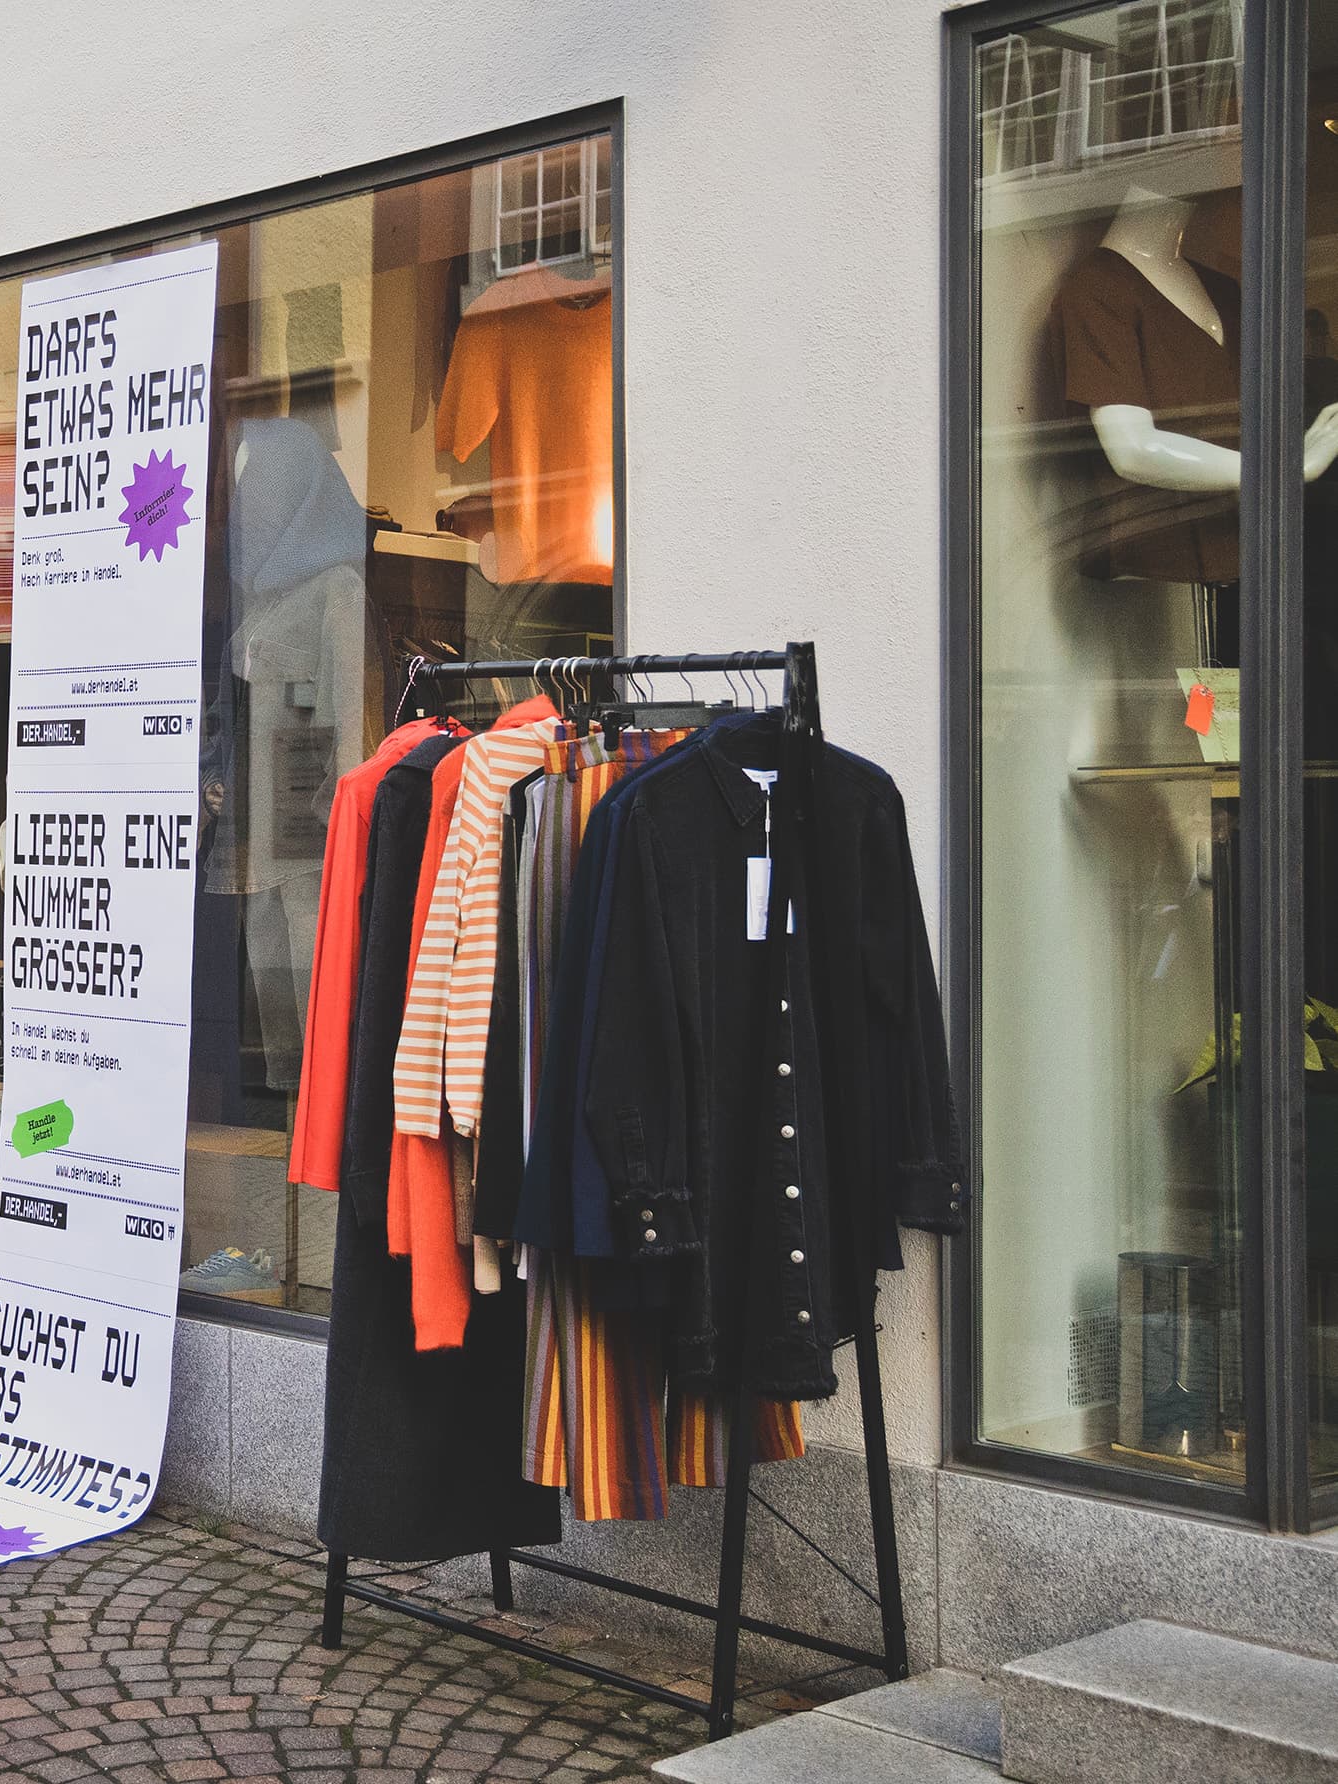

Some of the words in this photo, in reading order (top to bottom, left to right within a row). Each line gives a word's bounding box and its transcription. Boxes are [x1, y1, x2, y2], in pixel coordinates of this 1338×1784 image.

[26, 309, 117, 383] DARFS
[24, 379, 113, 450] ETWAS
[127, 363, 206, 434] MEHR
[23, 449, 110, 518] SEIN?
[147, 504, 169, 526] dich!
[21, 551, 41, 566] Denk
[45, 548, 65, 566] groß.
[21, 572, 41, 587] Mach
[44, 570, 78, 585] Karriere
[81, 567, 90, 582] im
[93, 564, 122, 581] Handel.
[71, 677, 139, 695] www.derhandel.at
[144, 716, 181, 735] WKO
[13, 813, 105, 867] LIEBER
[125, 814, 192, 870] EINE
[12, 875, 111, 931] NUMMER
[12, 936, 143, 999] GRÖSSER?
[12, 1021, 20, 1036] Im
[24, 1024, 47, 1039] Handel
[52, 1026, 76, 1042] wächst
[81, 1029, 90, 1043] du
[11, 1045, 37, 1060] schnell
[42, 1049, 51, 1062] an
[55, 1049, 79, 1065] deinen
[83, 1052, 122, 1070] Aufgaben.
[28, 1113, 56, 1131] Handle
[32, 1127, 54, 1145] jetzt!
[55, 1164, 122, 1187] www.derhandel.at
[126, 1216, 163, 1239] WKO
[102, 1327, 140, 1387] DU
